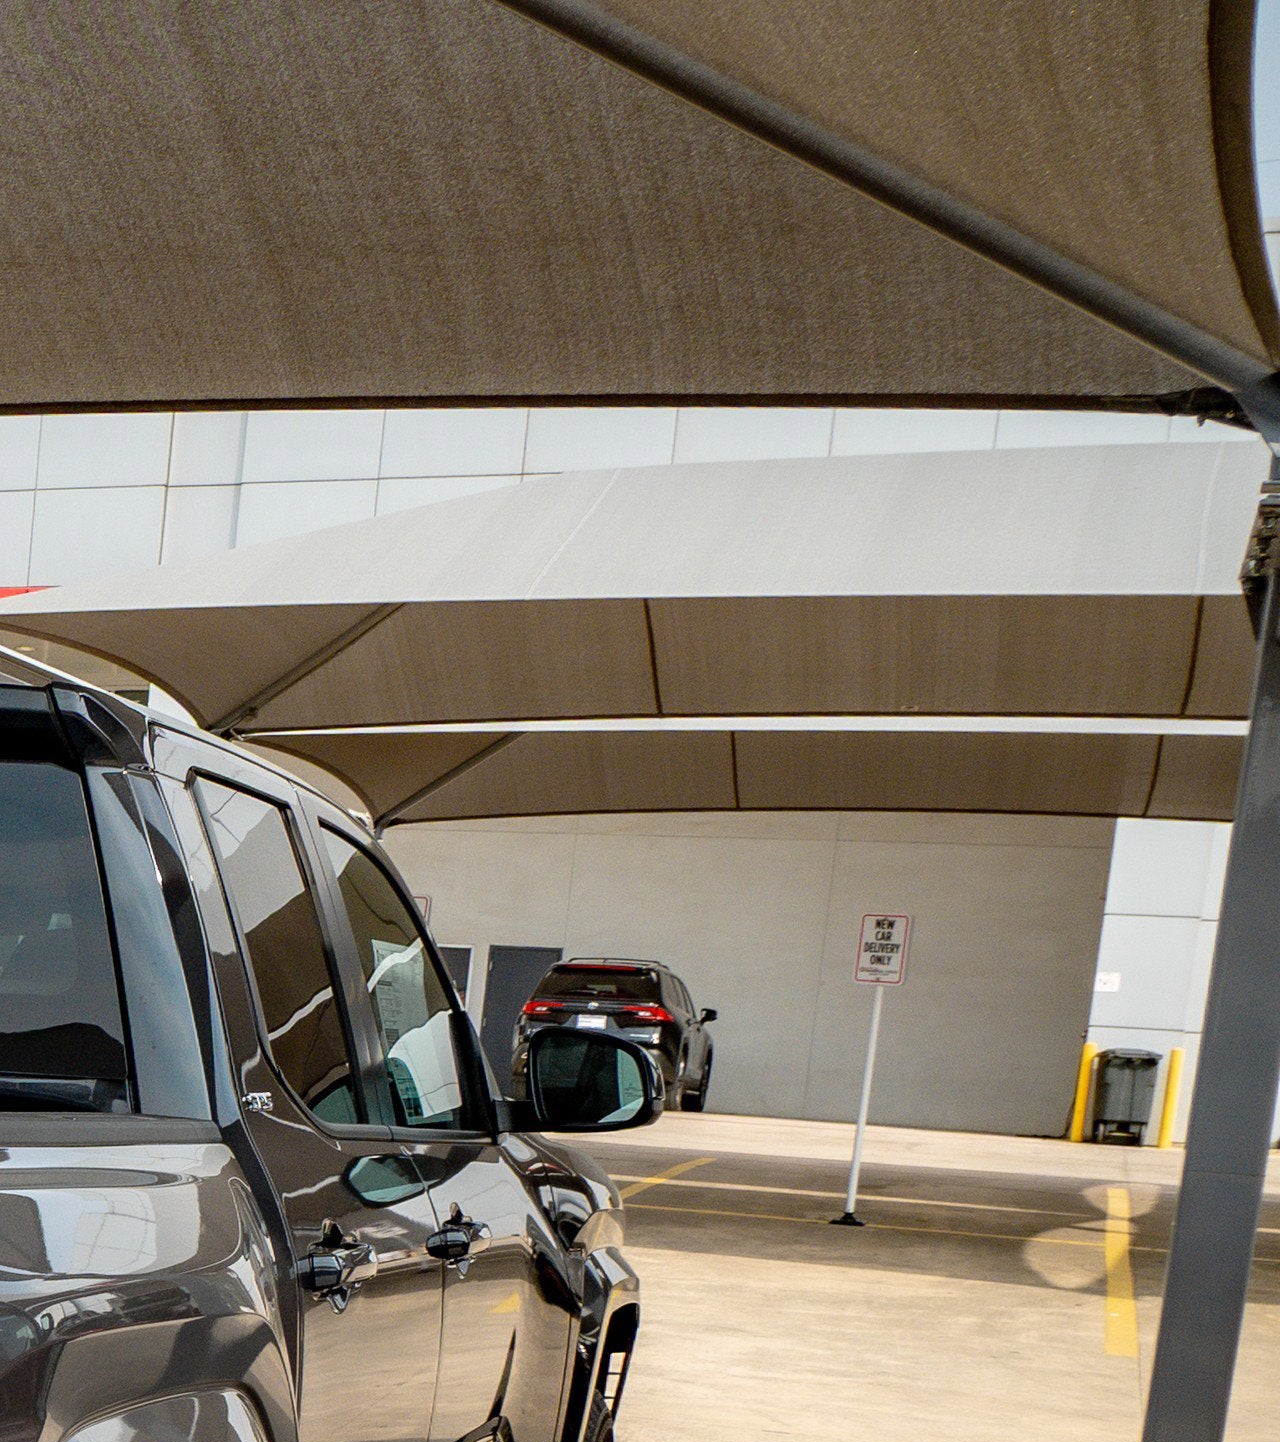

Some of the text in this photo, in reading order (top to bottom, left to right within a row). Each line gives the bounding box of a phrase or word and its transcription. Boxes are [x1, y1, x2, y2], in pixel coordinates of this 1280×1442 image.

[874, 919, 896, 929] NEW
[875, 931, 892, 941] CAR
[863, 942, 900, 953] DELIVERY
[870, 955, 893, 965] ONLY
